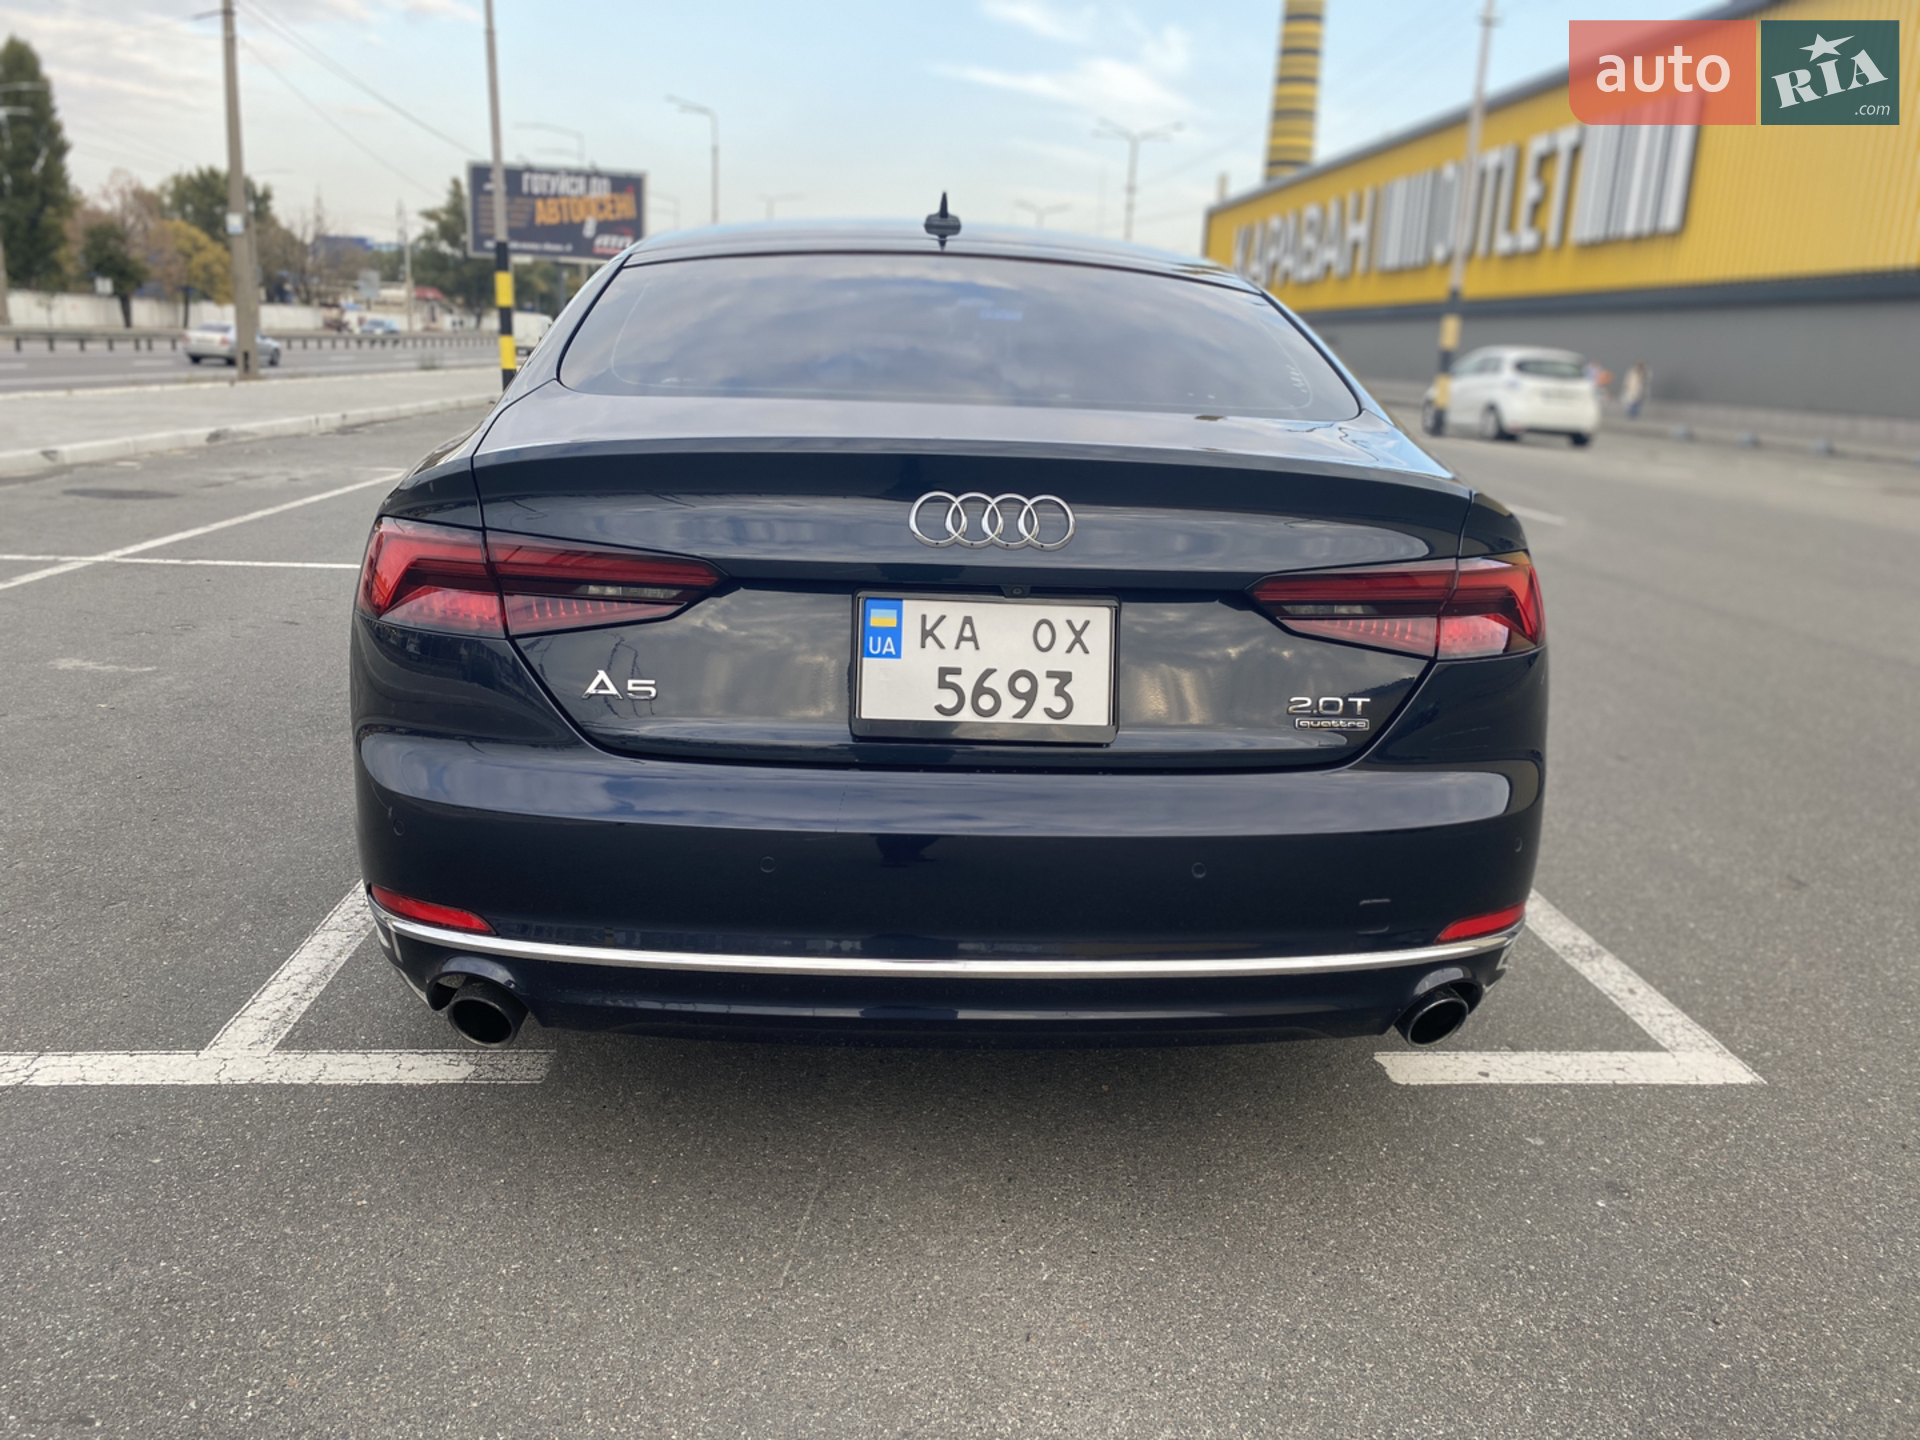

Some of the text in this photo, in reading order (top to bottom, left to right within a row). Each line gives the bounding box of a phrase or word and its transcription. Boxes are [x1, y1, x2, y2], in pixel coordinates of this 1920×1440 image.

[1233, 184, 1377, 287] КАРАВАН
[868, 636, 896, 655] UA
[920, 614, 1091, 654] KA OX
[582, 669, 657, 700] A5
[934, 666, 1074, 720] 5693
[1299, 720, 1367, 729] quattro
